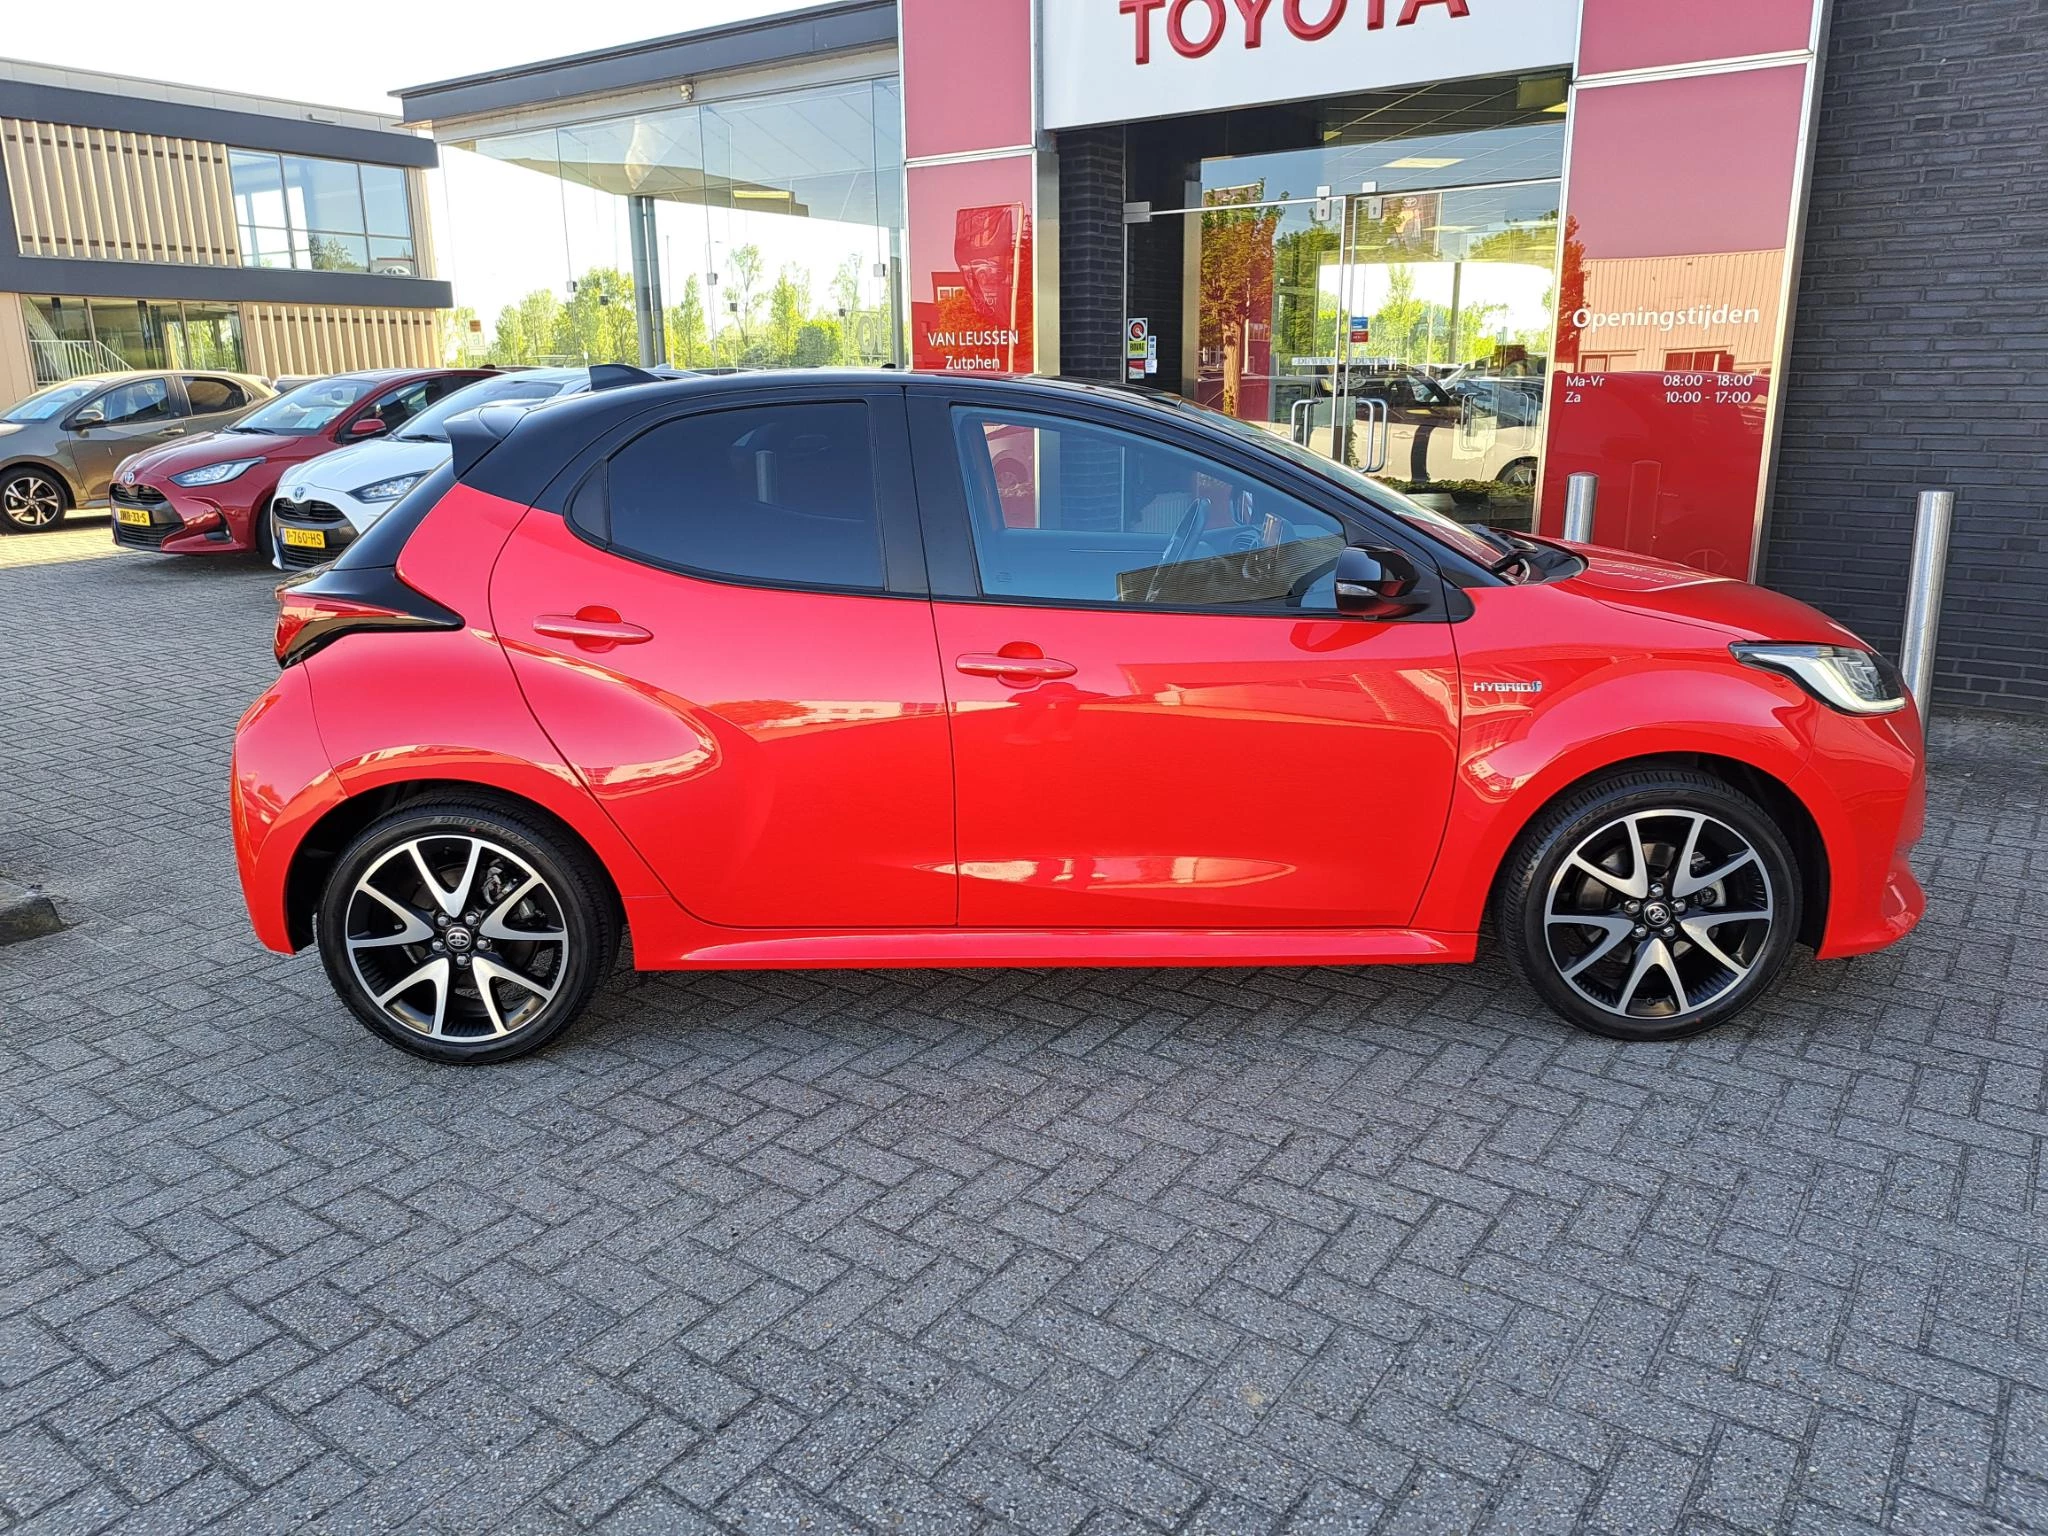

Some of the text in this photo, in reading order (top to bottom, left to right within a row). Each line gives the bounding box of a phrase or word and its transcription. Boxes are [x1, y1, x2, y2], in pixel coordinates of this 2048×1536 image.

[1572, 304, 1760, 333] Openingstijden
[927, 330, 1019, 346] VAN LEUSSEN
[945, 354, 1000, 371] Zutphen
[1565, 375, 1605, 387] Ma-Vr
[1663, 374, 1703, 387] 08:00
[1716, 374, 1753, 387] 18:00
[1565, 391, 1581, 404] Za
[1665, 391, 1701, 404] 10:00
[1715, 391, 1751, 404] 17:00
[286, 530, 322, 546] P-760-HS
[1473, 682, 1533, 692] HYBRID
